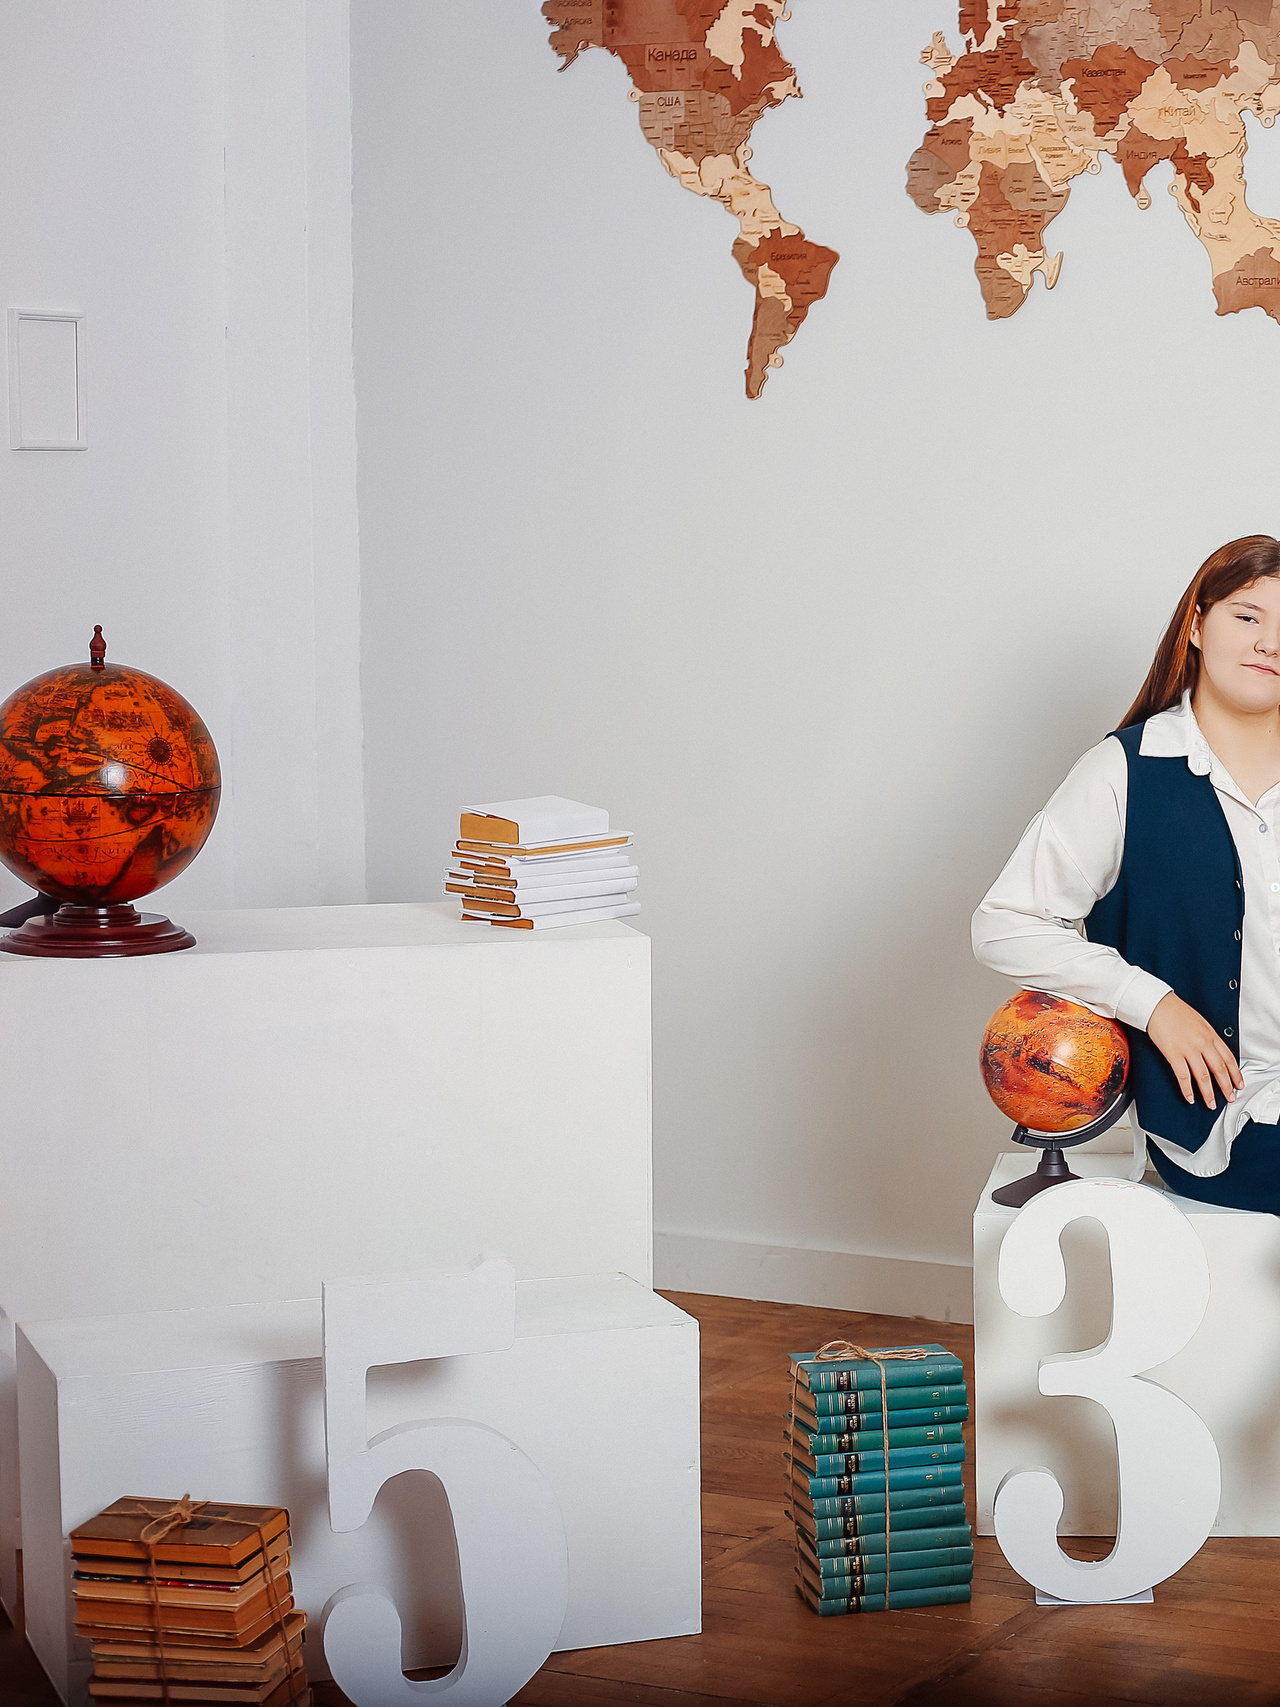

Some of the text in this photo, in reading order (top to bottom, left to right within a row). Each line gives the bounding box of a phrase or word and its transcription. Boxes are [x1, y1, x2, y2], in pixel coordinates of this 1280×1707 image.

[563, 17, 593, 26] Аляска
[648, 48, 697, 63] Канада
[1082, 69, 1126, 77] Казахстан
[657, 97, 681, 107] США
[1164, 107, 1196, 116] Китай
[1126, 150, 1157, 159] Индия
